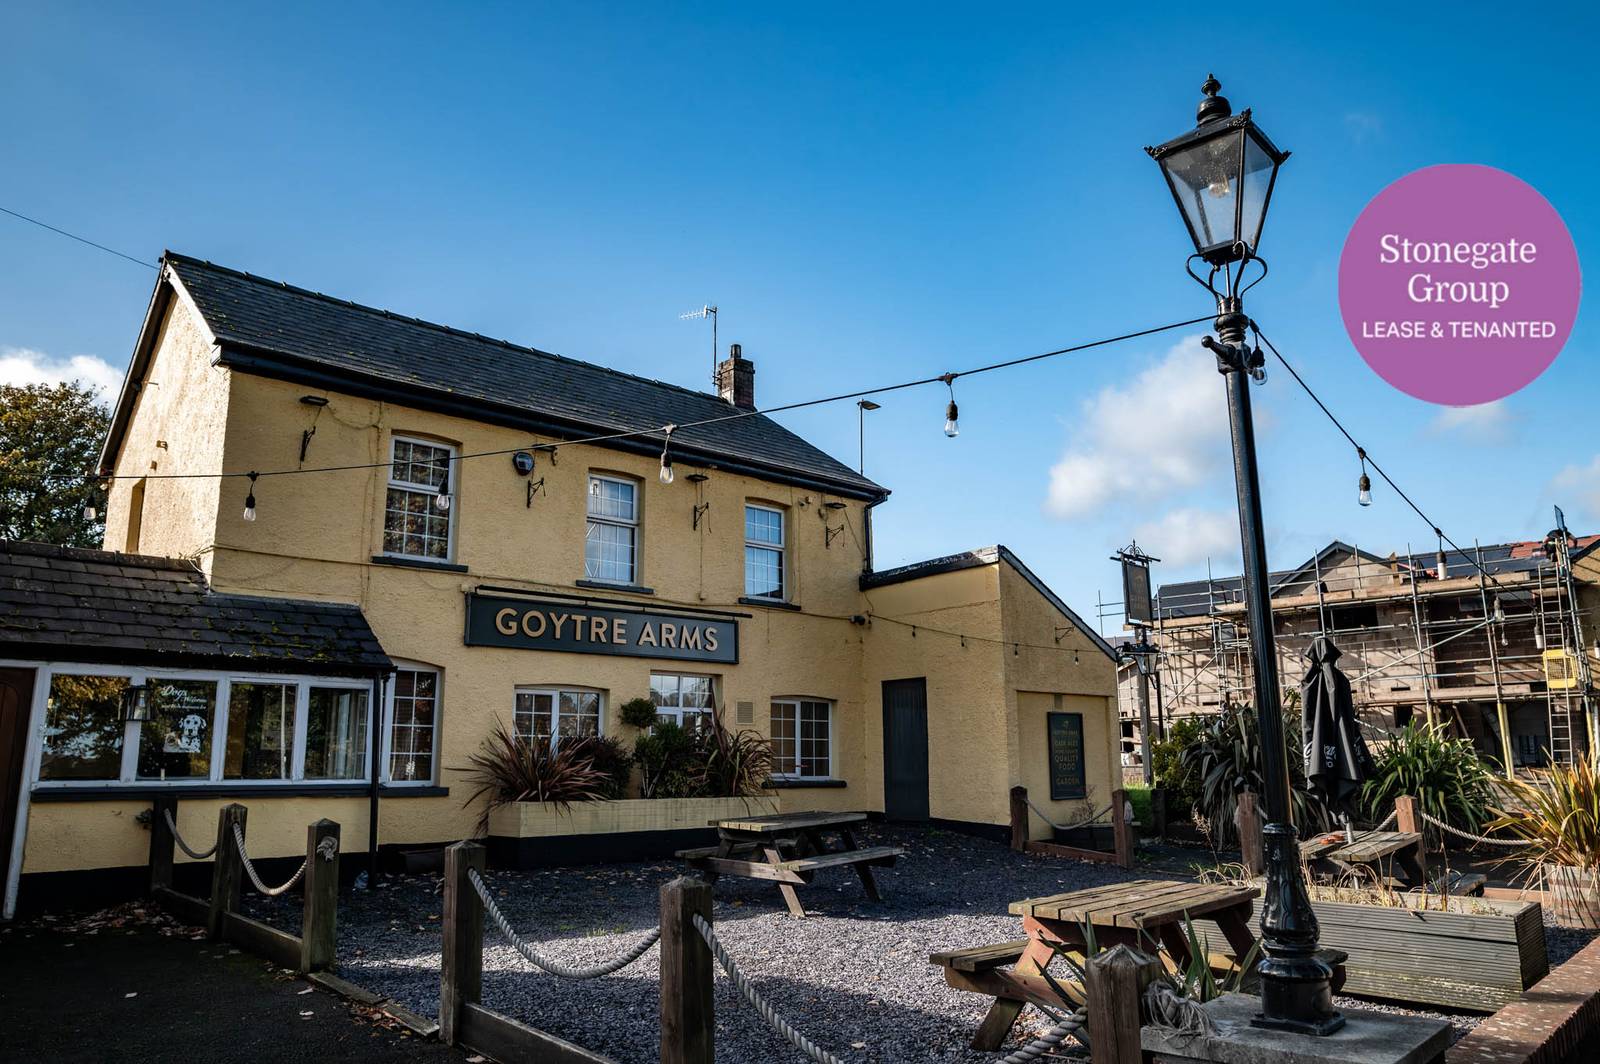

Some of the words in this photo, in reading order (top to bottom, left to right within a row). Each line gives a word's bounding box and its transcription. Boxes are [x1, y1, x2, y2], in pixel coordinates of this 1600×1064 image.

[496, 607, 628, 645] GOYTRE
[637, 621, 719, 651] ARMS
[161, 685, 188, 701] Dogs
[1055, 754, 1079, 762] QUALITY
[1059, 763, 1076, 771] FOOD
